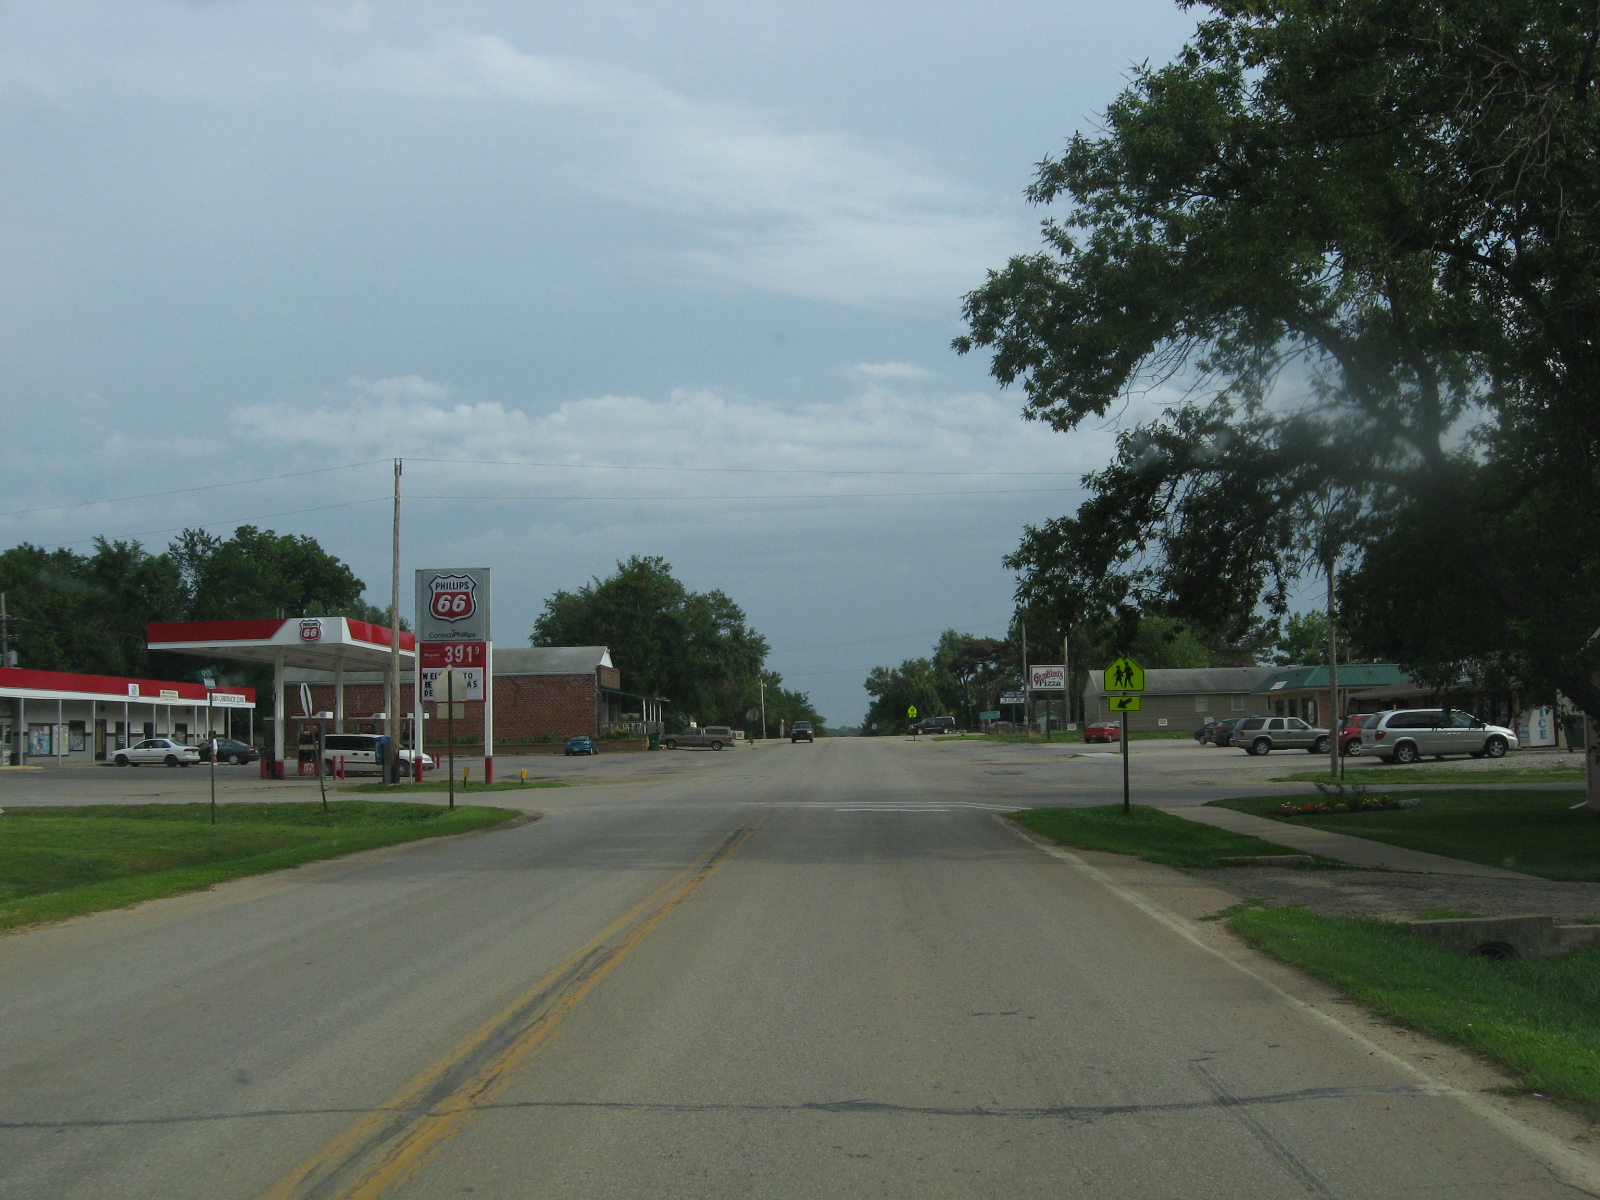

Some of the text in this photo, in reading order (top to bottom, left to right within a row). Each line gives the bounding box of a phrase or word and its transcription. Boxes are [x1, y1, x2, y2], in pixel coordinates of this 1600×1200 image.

[435, 581, 470, 590] PHILLIPS
[437, 594, 467, 613] 66
[303, 628, 317, 638] 66
[429, 631, 476, 639] ConocoPhillips
[463, 672, 473, 680] TO
[1033, 669, 1063, 685] Gambino's
[1039, 679, 1062, 687] Pizza
[1538, 706, 1547, 740] ICE
